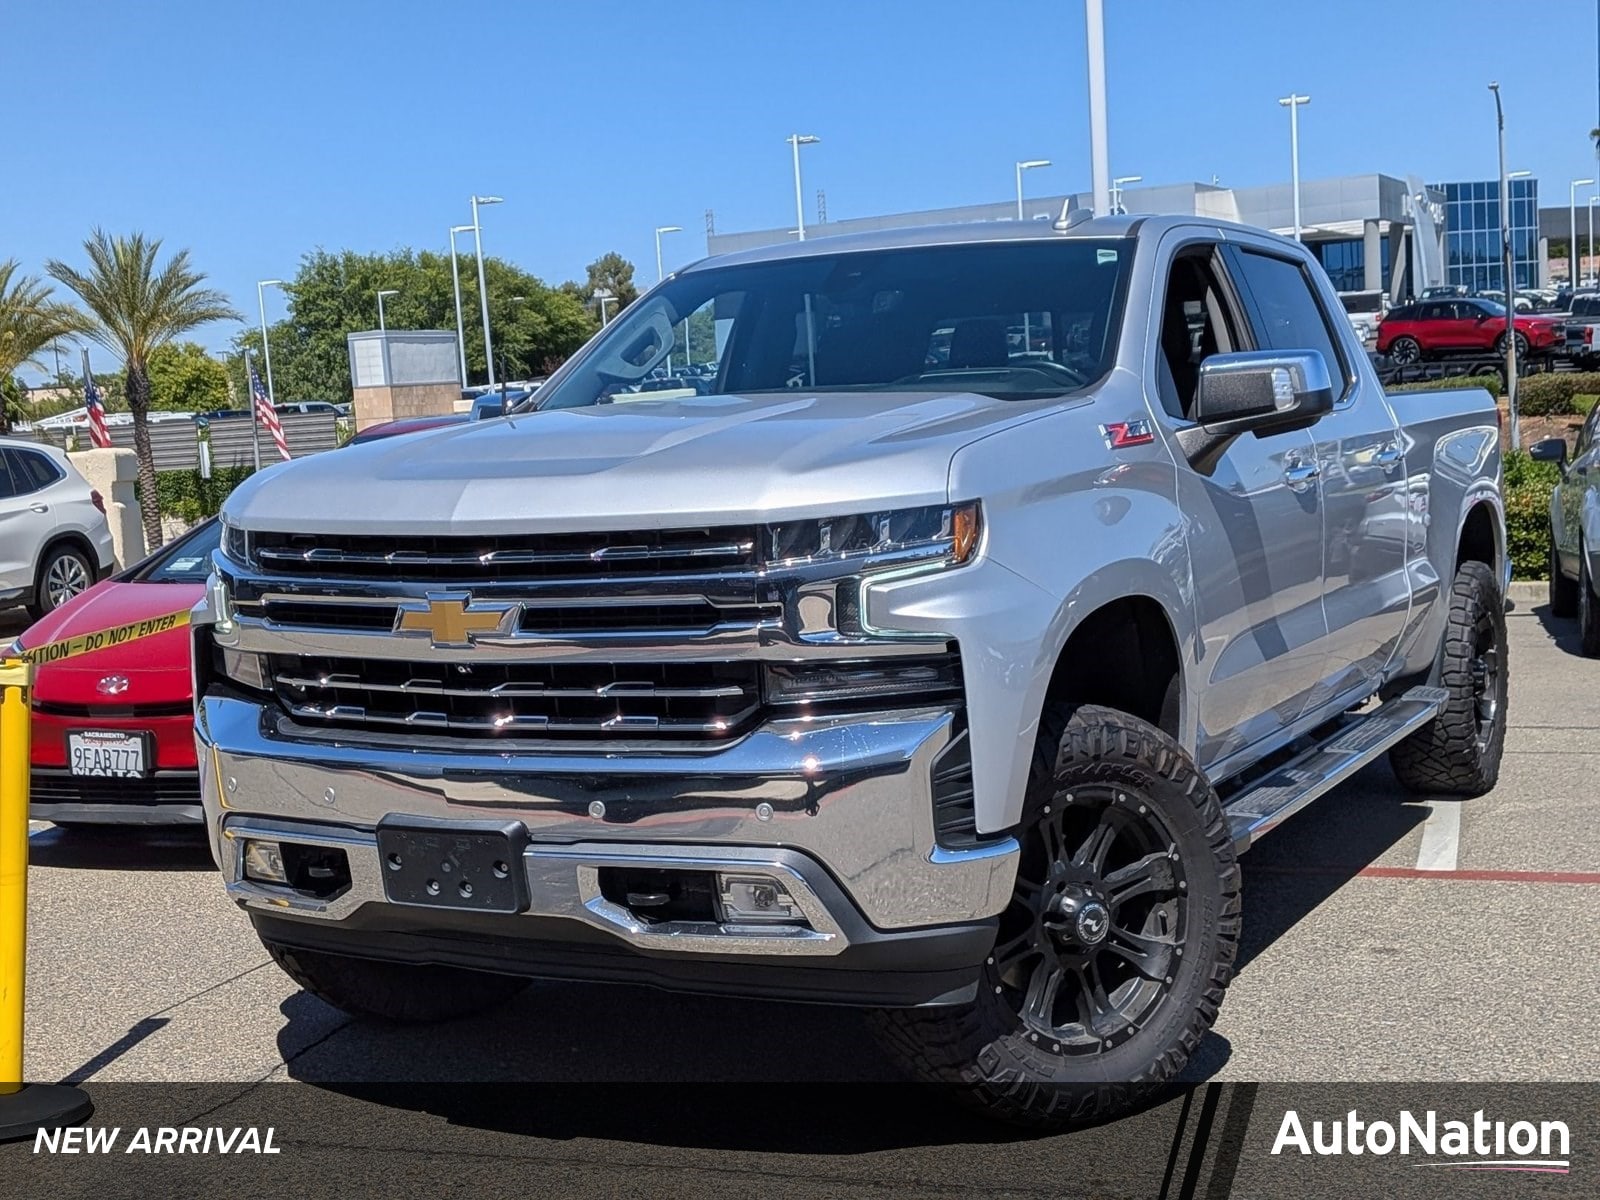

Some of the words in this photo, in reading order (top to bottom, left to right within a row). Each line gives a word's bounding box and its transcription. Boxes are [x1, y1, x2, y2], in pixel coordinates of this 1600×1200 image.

[85, 633, 104, 651] DO
[108, 624, 135, 645] NOT
[138, 614, 176, 637] ENTER
